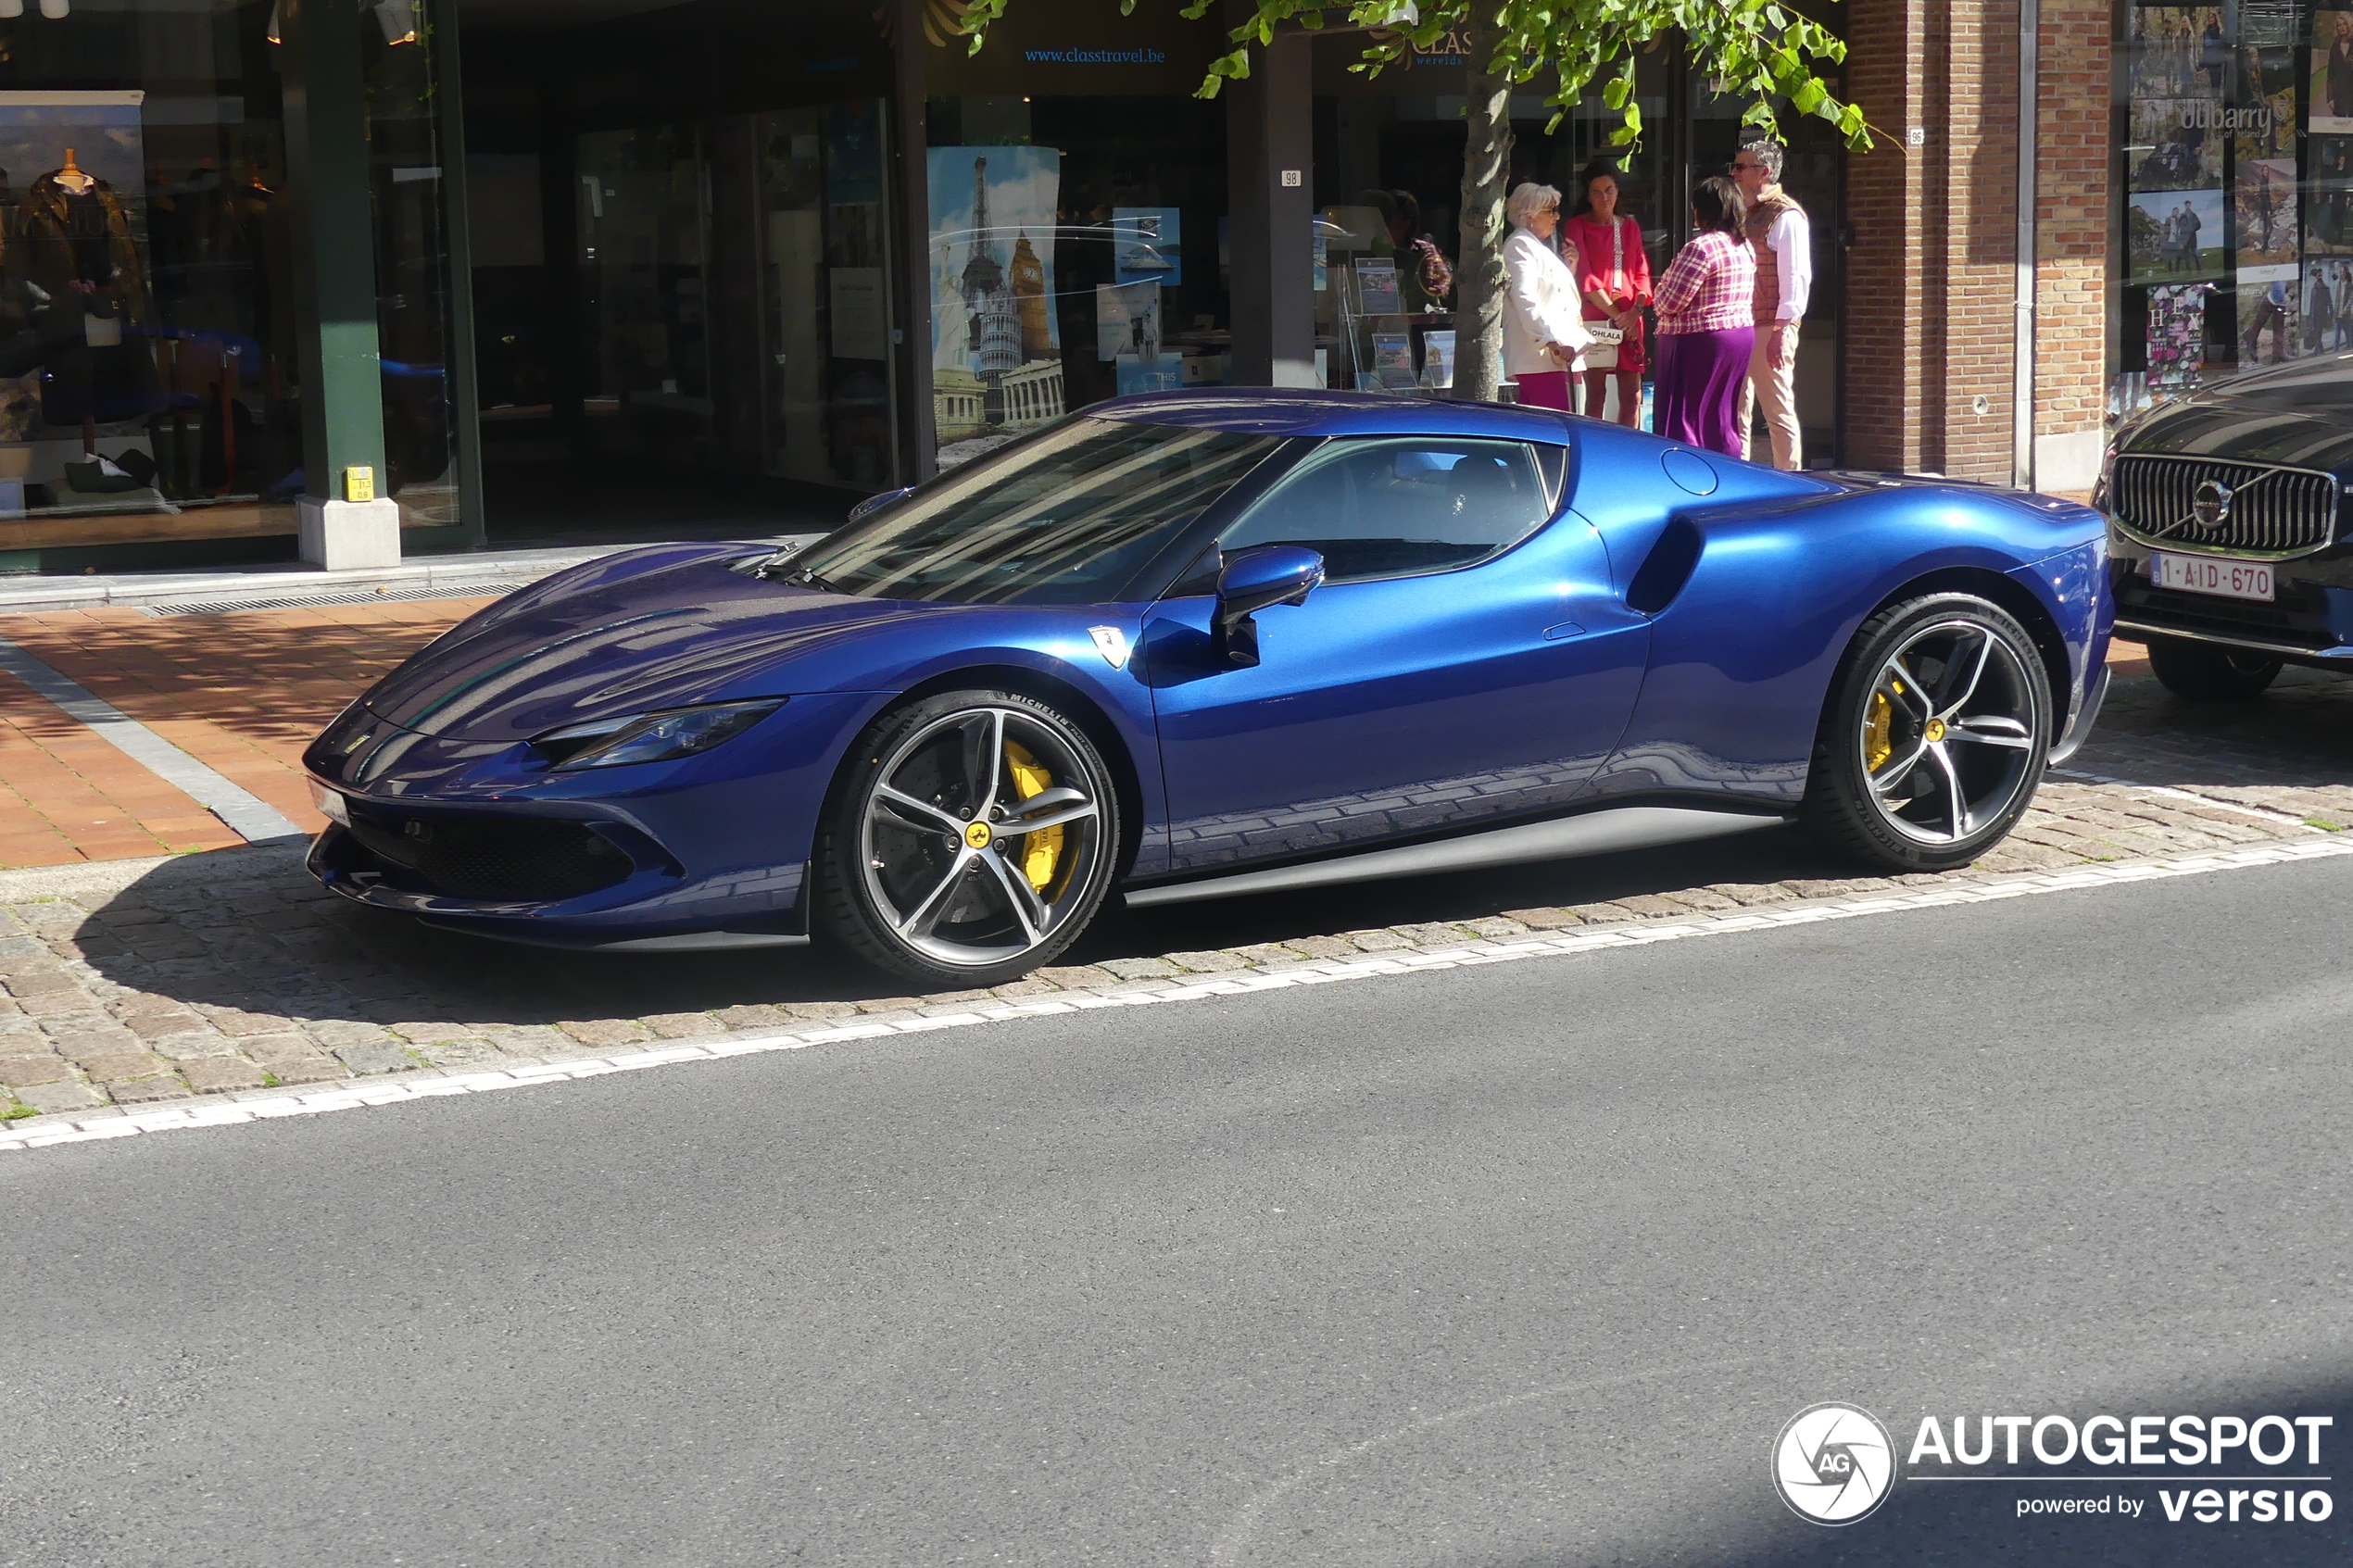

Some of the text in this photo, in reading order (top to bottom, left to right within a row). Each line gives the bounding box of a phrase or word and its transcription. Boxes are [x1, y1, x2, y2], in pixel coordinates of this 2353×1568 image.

[1412, 31, 1472, 55] CLAS
[1025, 47, 1165, 63] www.classtravel.be
[2181, 97, 2271, 138] dubarry
[1912, 132, 1921, 142] 96
[1287, 172, 1297, 185] 98
[1589, 330, 1621, 340] OHLALA
[1157, 372, 1176, 382] THIS
[2153, 571, 2160, 583] B
[2163, 558, 2269, 595] 1-AID-670
[1010, 693, 1069, 726] MICHELIN
[1070, 727, 1086, 744] PILOT
